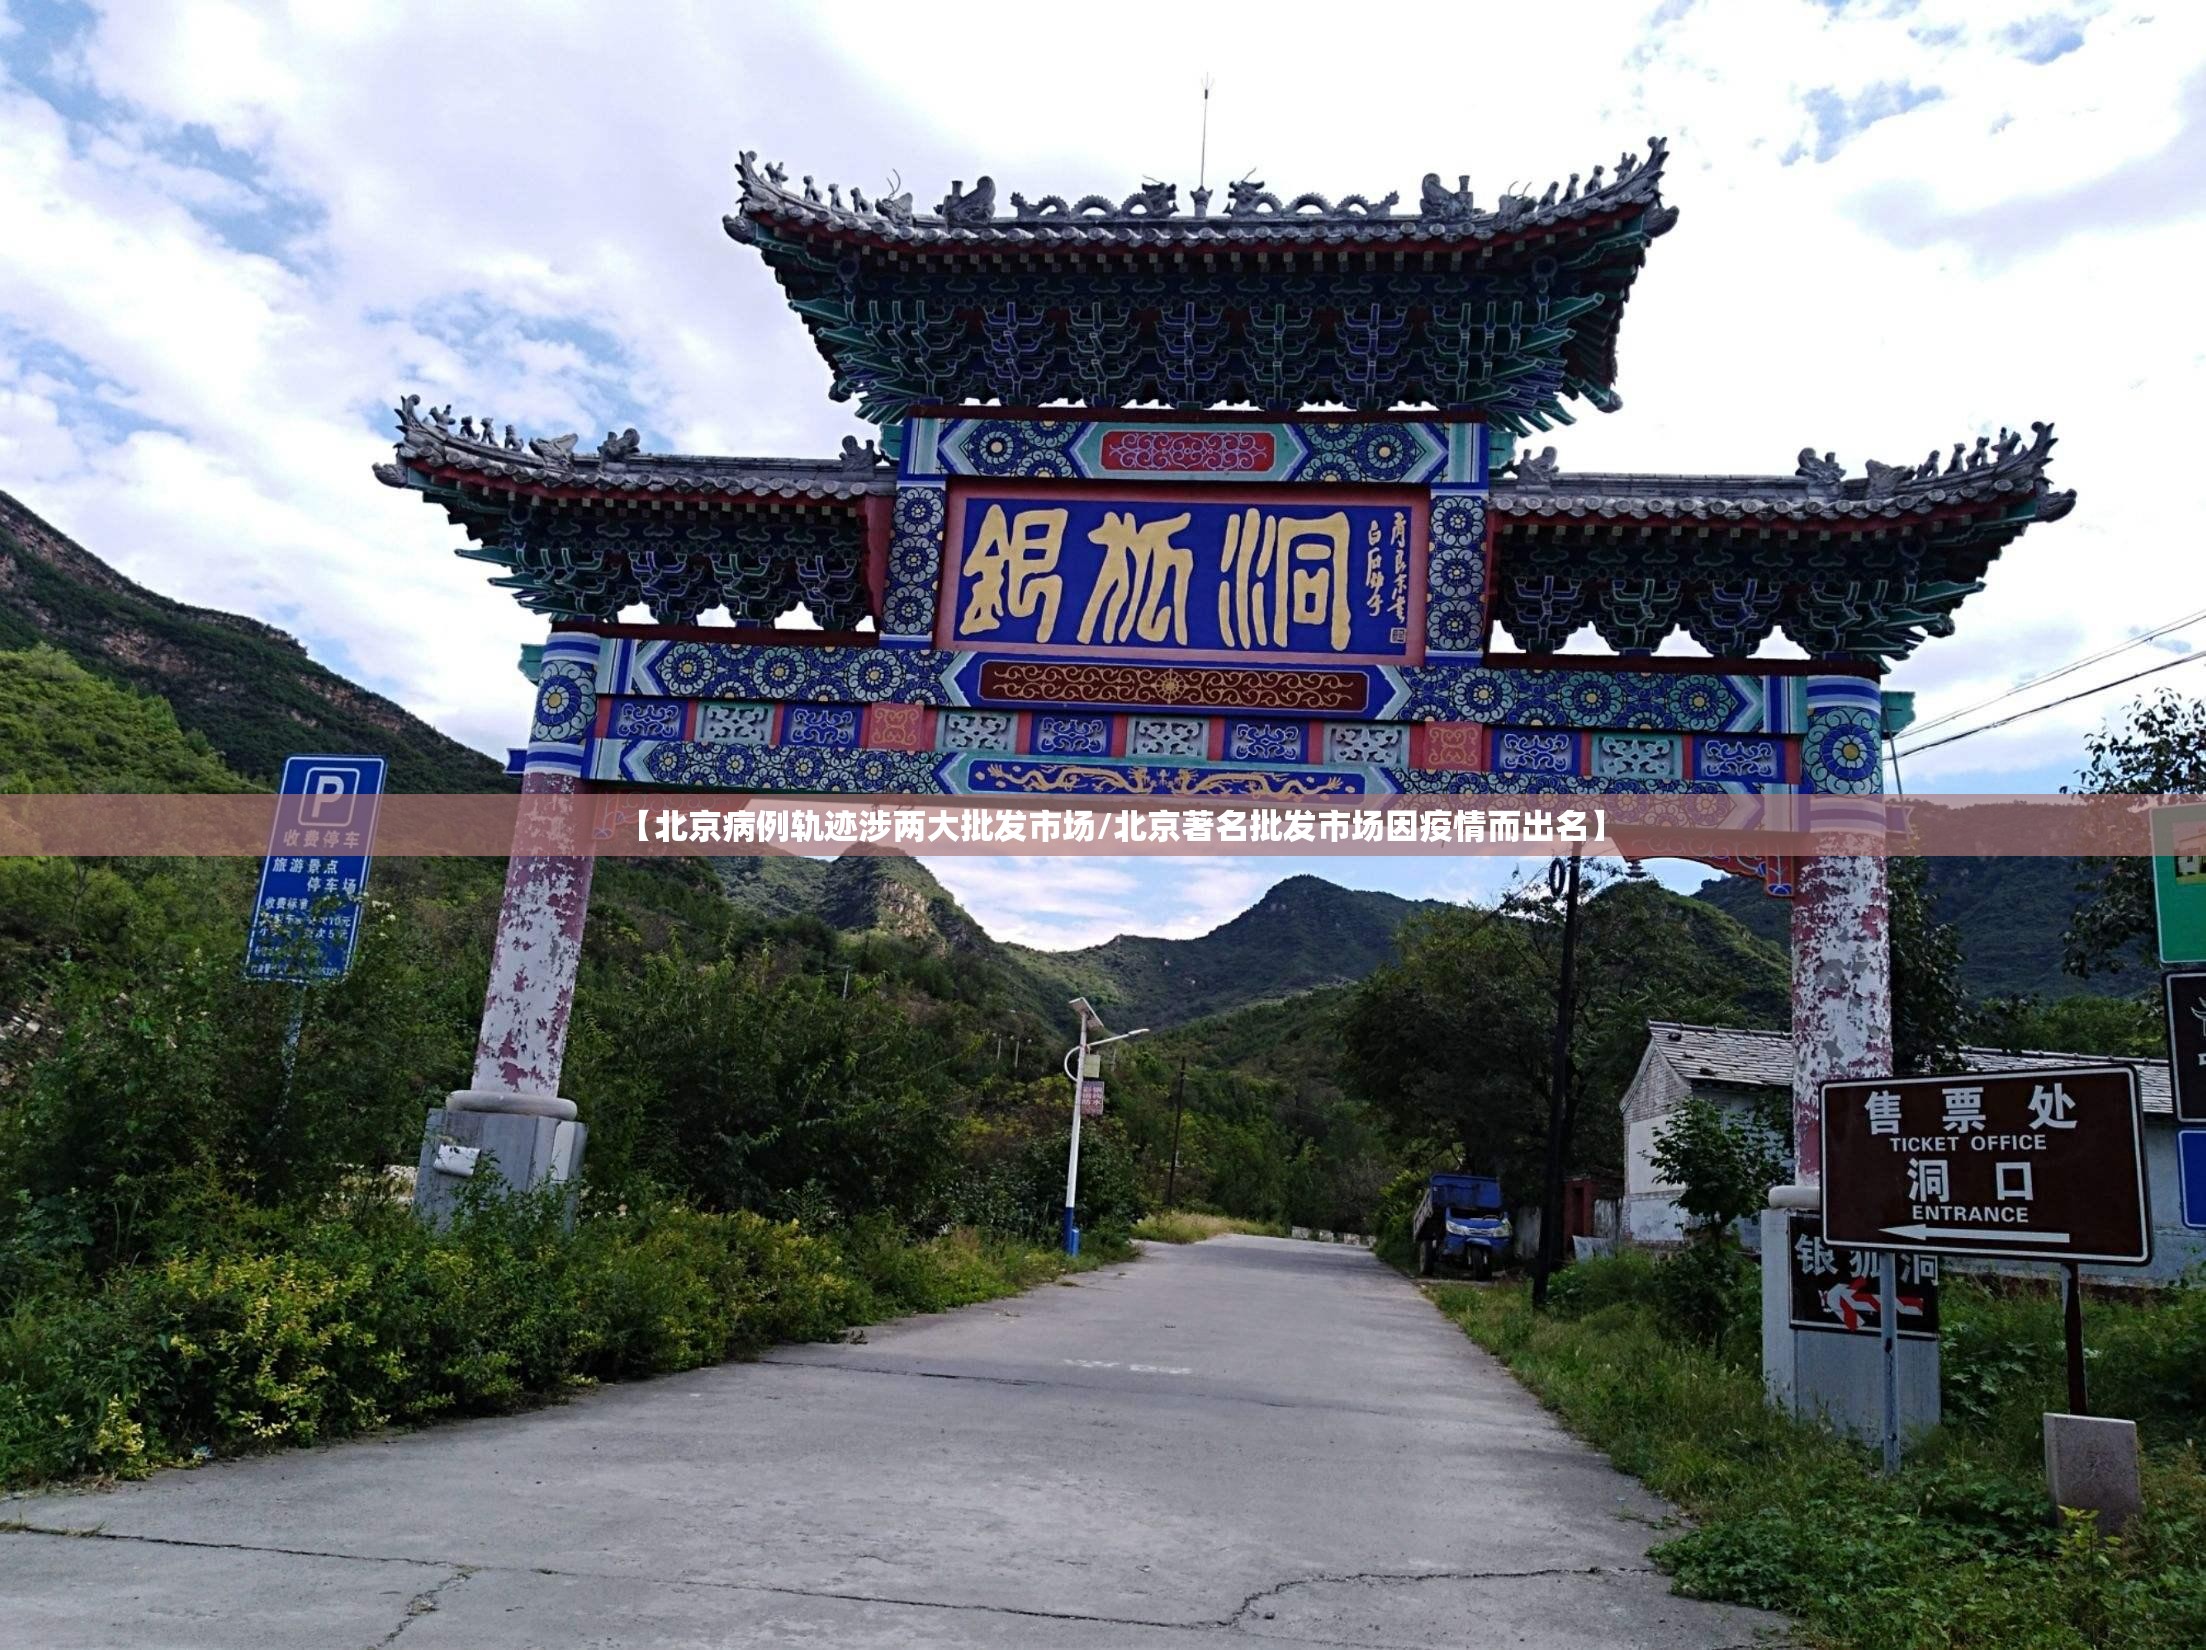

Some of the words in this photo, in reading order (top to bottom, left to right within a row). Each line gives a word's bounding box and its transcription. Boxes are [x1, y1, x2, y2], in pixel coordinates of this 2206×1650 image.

[311, 775, 345, 818] P
[283, 829, 360, 849] 收费停车
[272, 857, 339, 874] 旅游景点
[307, 876, 357, 897] 停车场
[1864, 1082, 2078, 1136] 售票处
[1889, 1136, 1960, 1152] TICKET
[1970, 1134, 2047, 1151] OFFICE
[1907, 1157, 2034, 1203] 洞口
[1912, 1205, 2029, 1224] ENTRANCE
